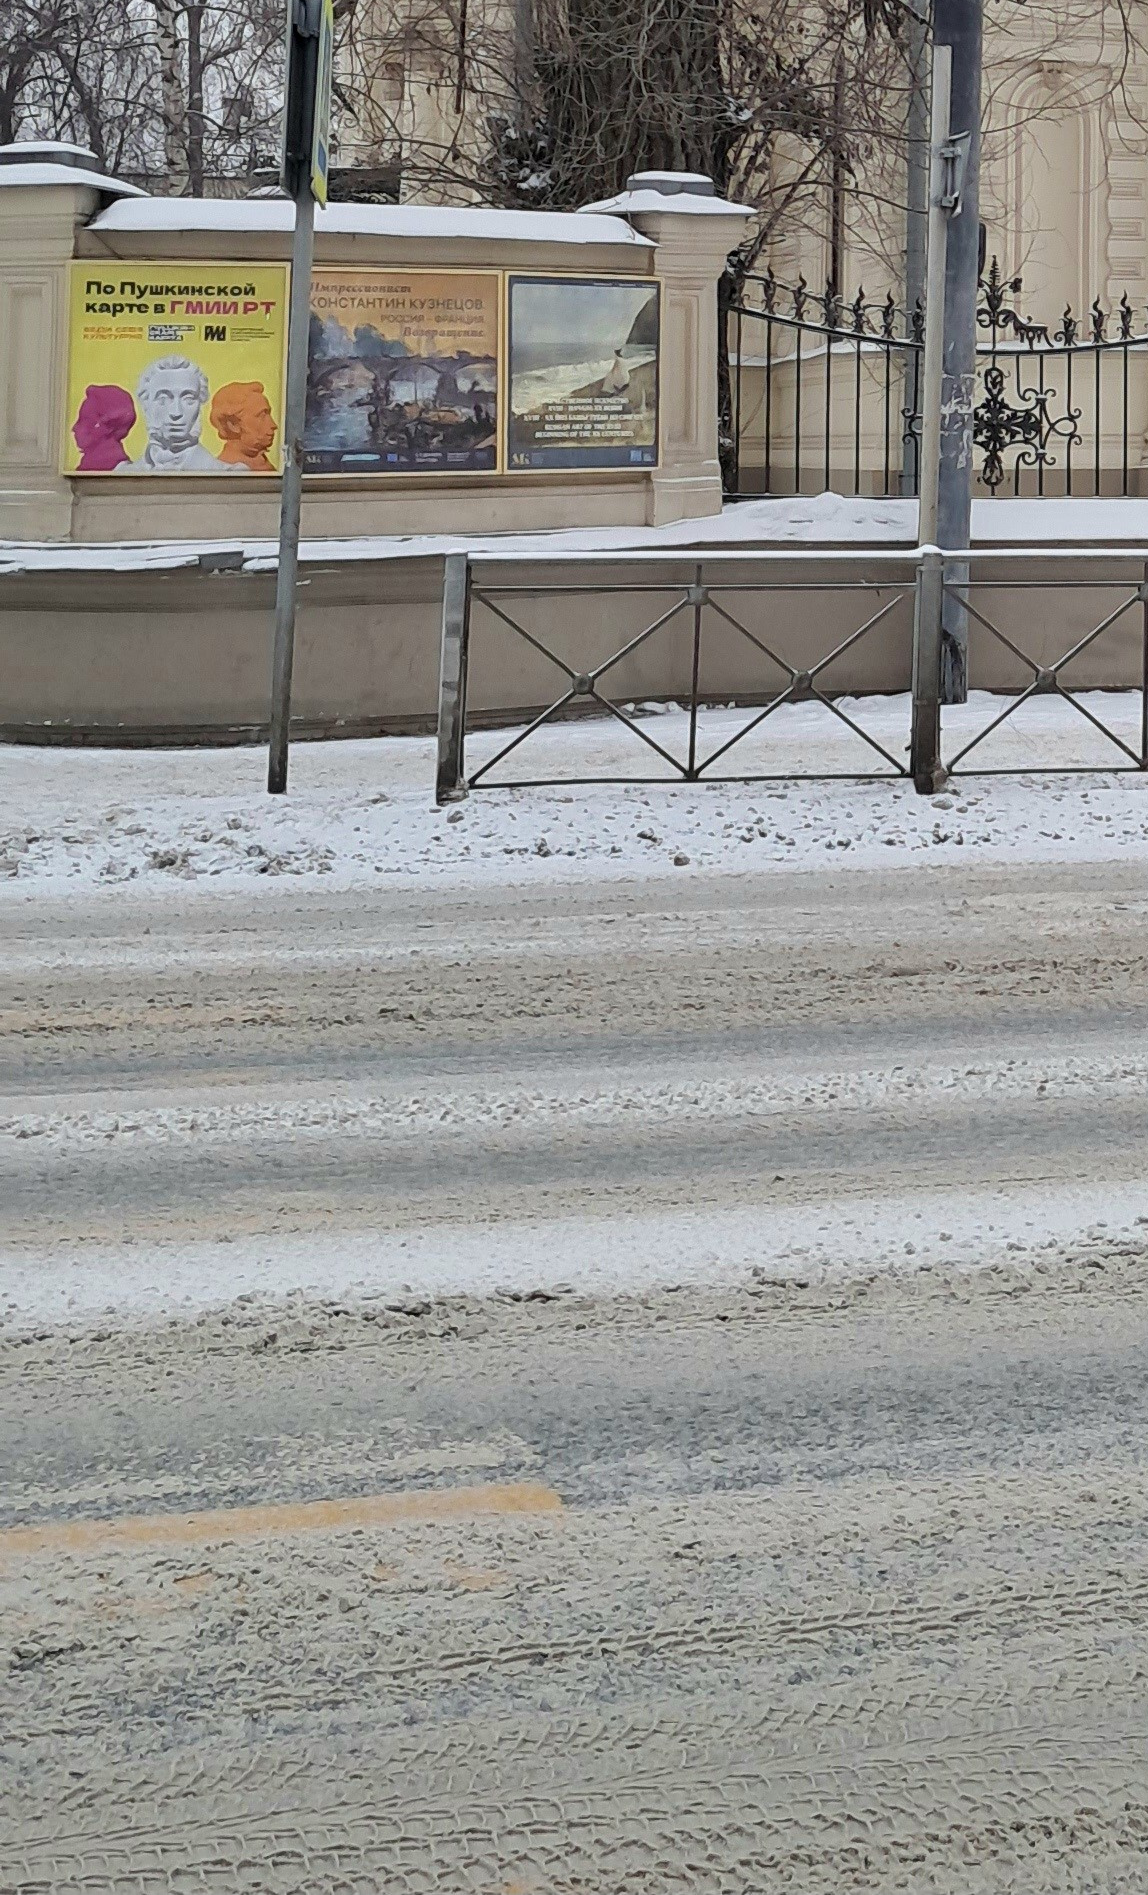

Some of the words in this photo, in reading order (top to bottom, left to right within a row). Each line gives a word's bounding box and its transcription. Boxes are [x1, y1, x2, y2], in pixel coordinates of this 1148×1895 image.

[86, 281, 115, 295] По
[120, 282, 256, 299] Пушкинской
[85, 302, 149, 317] карте
[154, 304, 165, 314] в
[170, 301, 238, 314] ГМИИ
[243, 302, 276, 316] РТ
[409, 299, 483, 312] КУЗНЕЦОВ
[380, 314, 425, 323] РОССИЯ
[434, 315, 484, 325] ФРАНЦИЯ
